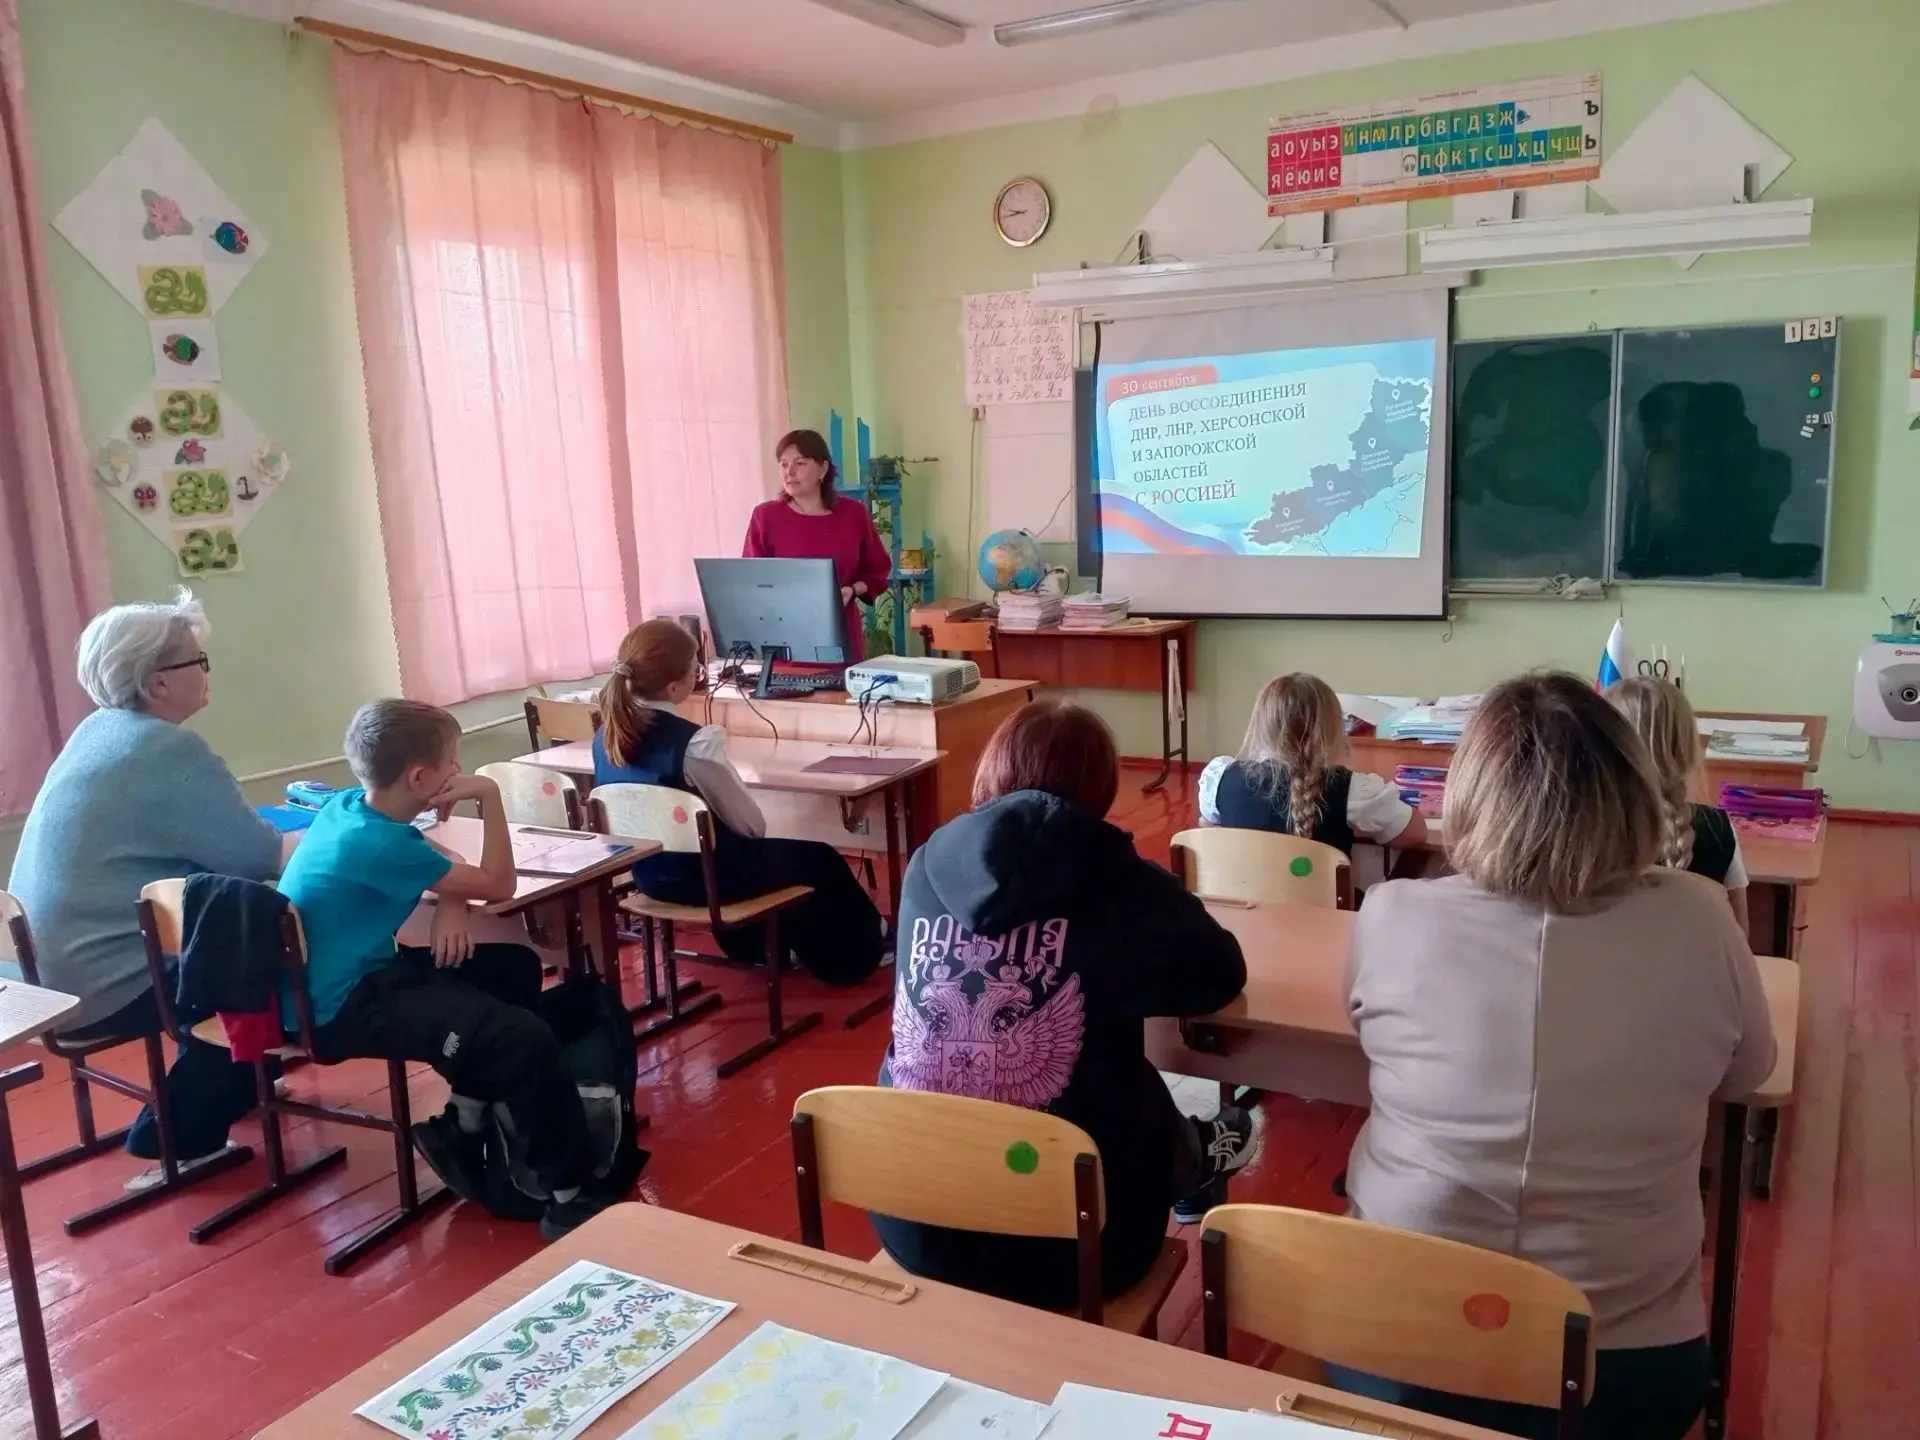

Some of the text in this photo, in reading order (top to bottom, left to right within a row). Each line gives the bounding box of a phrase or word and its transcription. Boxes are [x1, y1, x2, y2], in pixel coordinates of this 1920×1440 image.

[1791, 321, 1831, 339] 1 2 3
[1121, 372, 1197, 395] 30 сентября
[1128, 382, 1307, 423] ДЕНЬ ВОССОЕДИНЕНИЯ
[1130, 402, 1306, 444] ДНР, ЛНР, ХЕРСОНСКОЙ
[1132, 432, 1257, 463] И ЗАПОРОЖСКОЙ
[1133, 461, 1208, 484] ОБЛАСТЕЙ
[1135, 479, 1237, 506] С РОССИЕЙ
[909, 913, 1069, 972] РОИЯ
